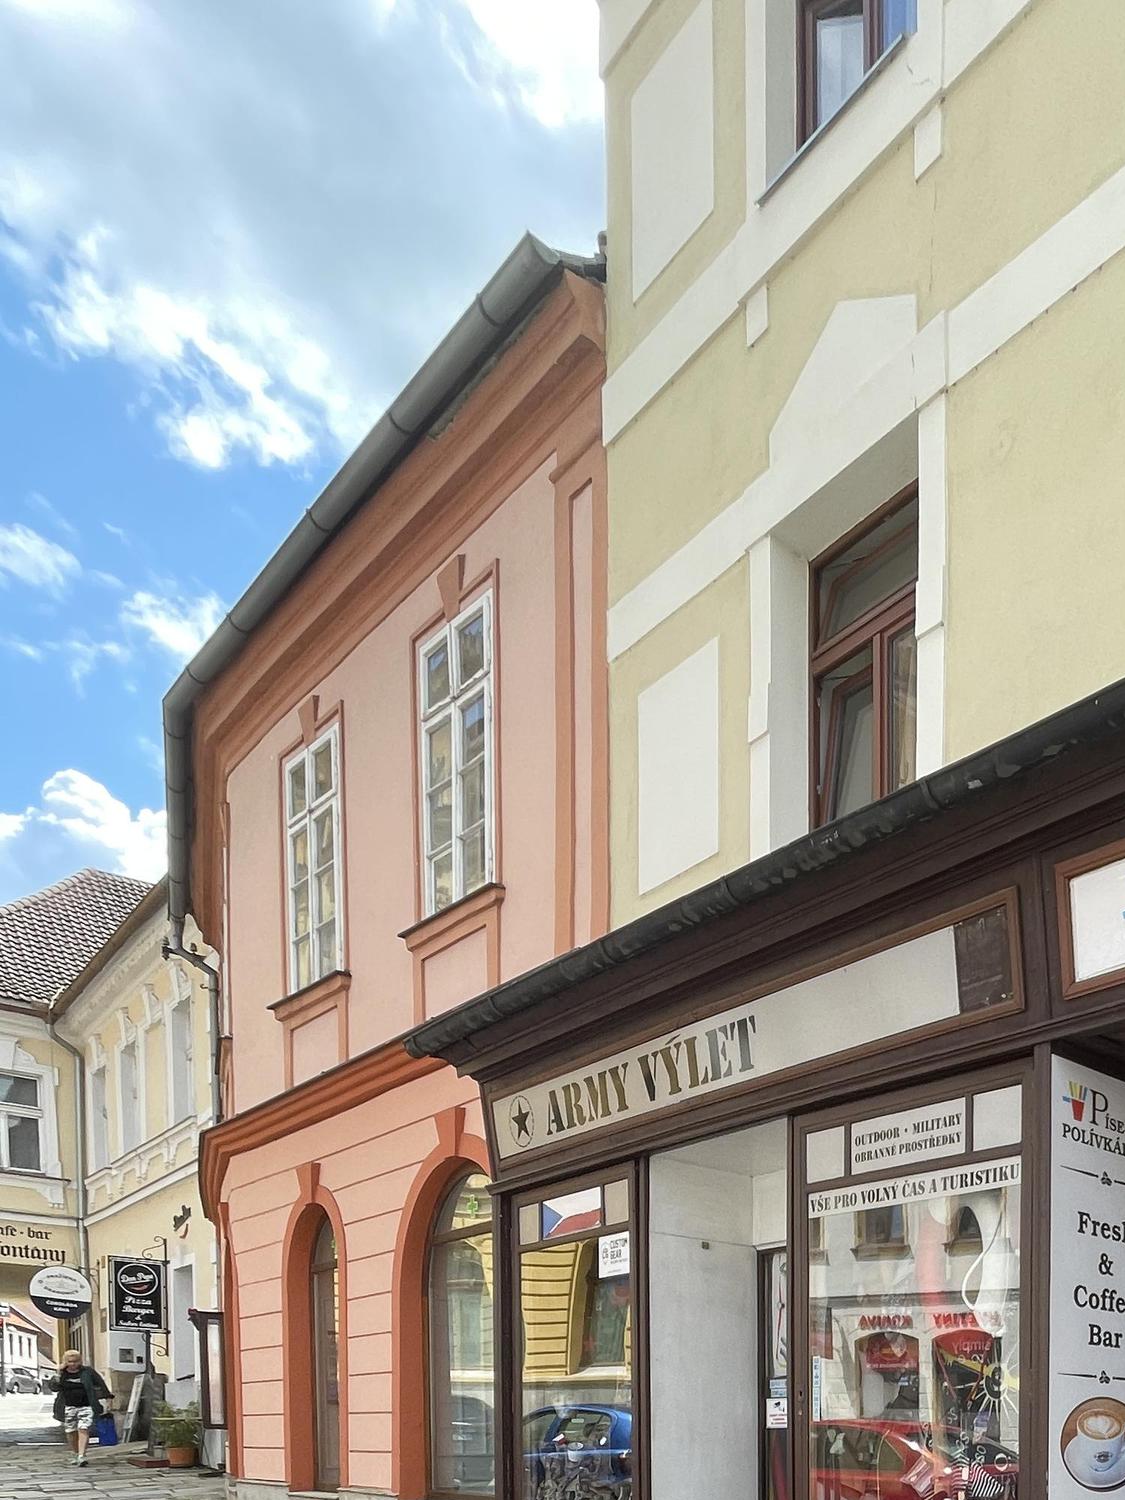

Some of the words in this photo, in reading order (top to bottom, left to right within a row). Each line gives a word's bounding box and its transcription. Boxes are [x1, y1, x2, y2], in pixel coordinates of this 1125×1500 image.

[547, 1062, 629, 1136] ARMY
[637, 1015, 757, 1102] VÝLET
[855, 1127, 900, 1147] OUTDOOR
[912, 1113, 962, 1135] MILITARY
[855, 1145, 897, 1164] OBRANNÉ
[899, 1131, 962, 1155] PROSTŘEDKY
[810, 1194, 831, 1213] VŠE
[834, 1191, 858, 1210] PRO
[860, 1181, 900, 1204] VOLNÝ
[902, 1178, 925, 1198] ČAS
[929, 1178, 937, 1194] A
[941, 1163, 1020, 1190] TURISTIKU
[28, 1227, 52, 1240] bar
[0, 1243, 65, 1264] ontány
[1099, 1253, 1114, 1276] &
[1088, 1324, 1123, 1349] Bar
